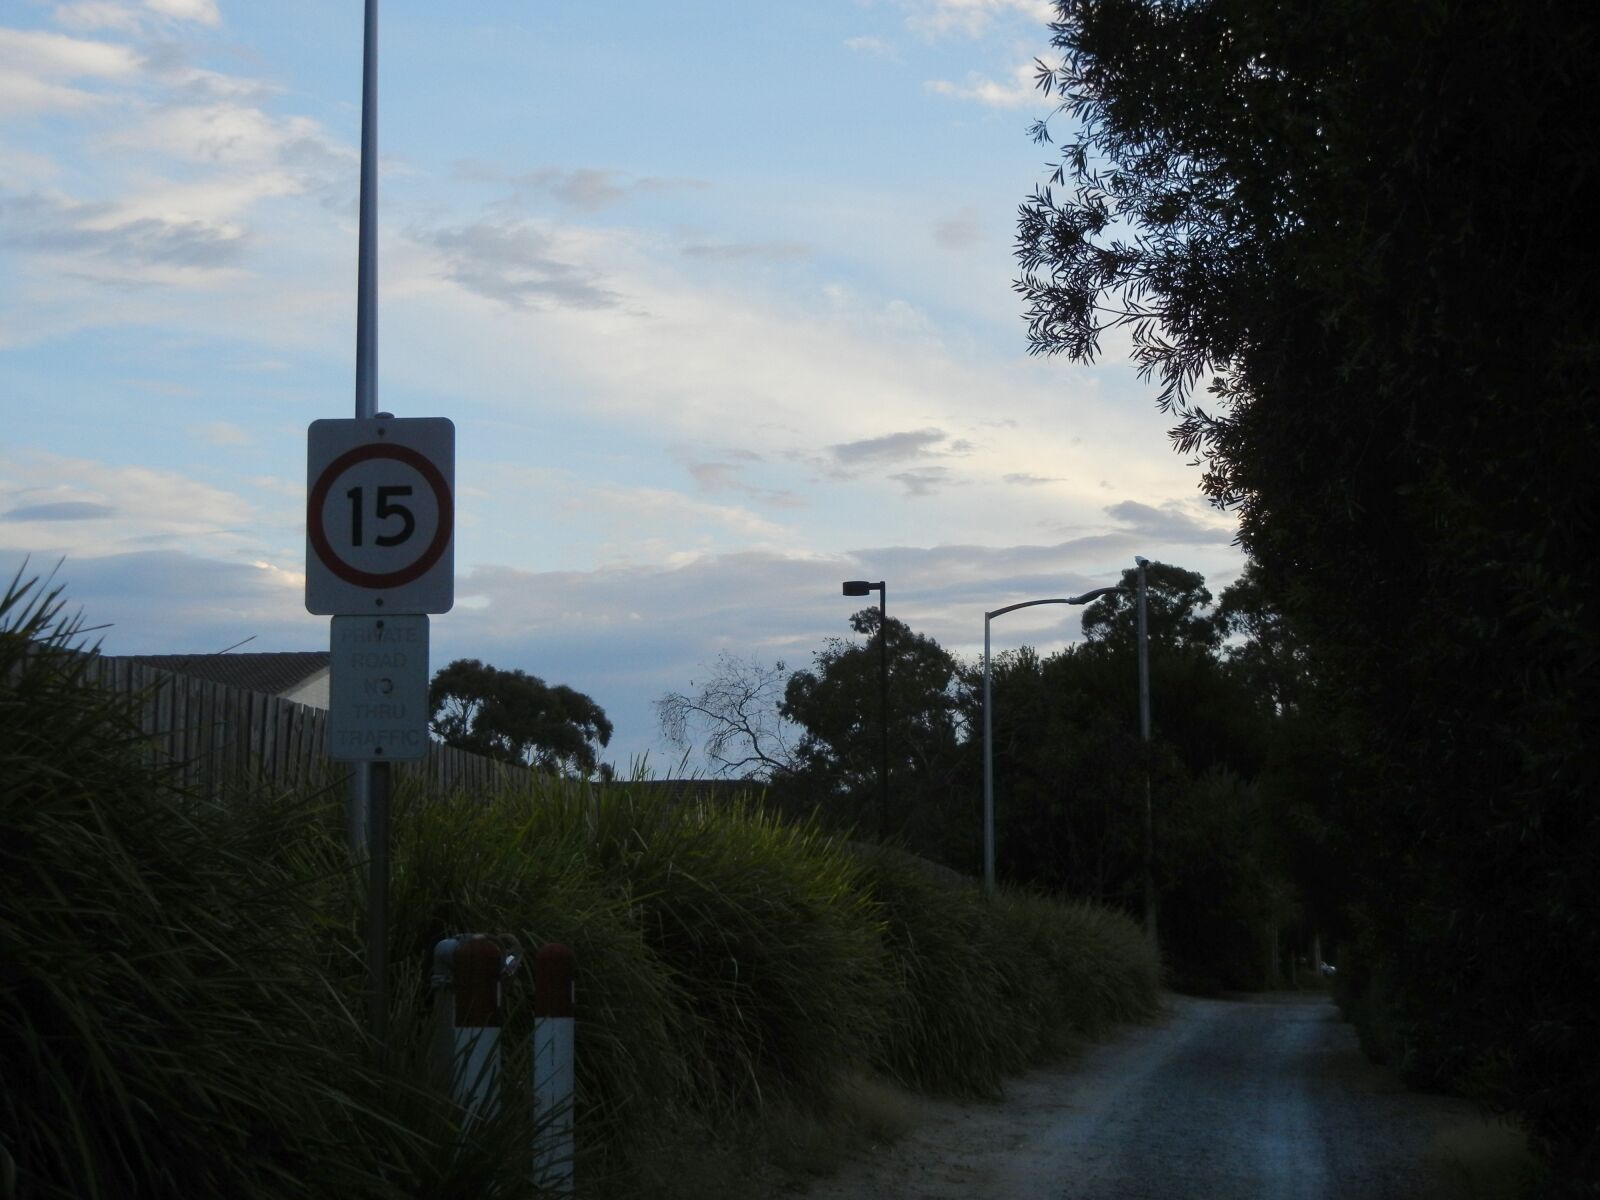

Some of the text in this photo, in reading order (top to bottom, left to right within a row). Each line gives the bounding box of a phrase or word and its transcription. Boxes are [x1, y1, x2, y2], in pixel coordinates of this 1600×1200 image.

[347, 485, 415, 548] 15
[341, 627, 417, 643] PRIVATE
[351, 652, 408, 668] ROAD
[364, 677, 394, 695] NO
[351, 704, 406, 720] THRU
[336, 730, 420, 745] TRAFFIC
